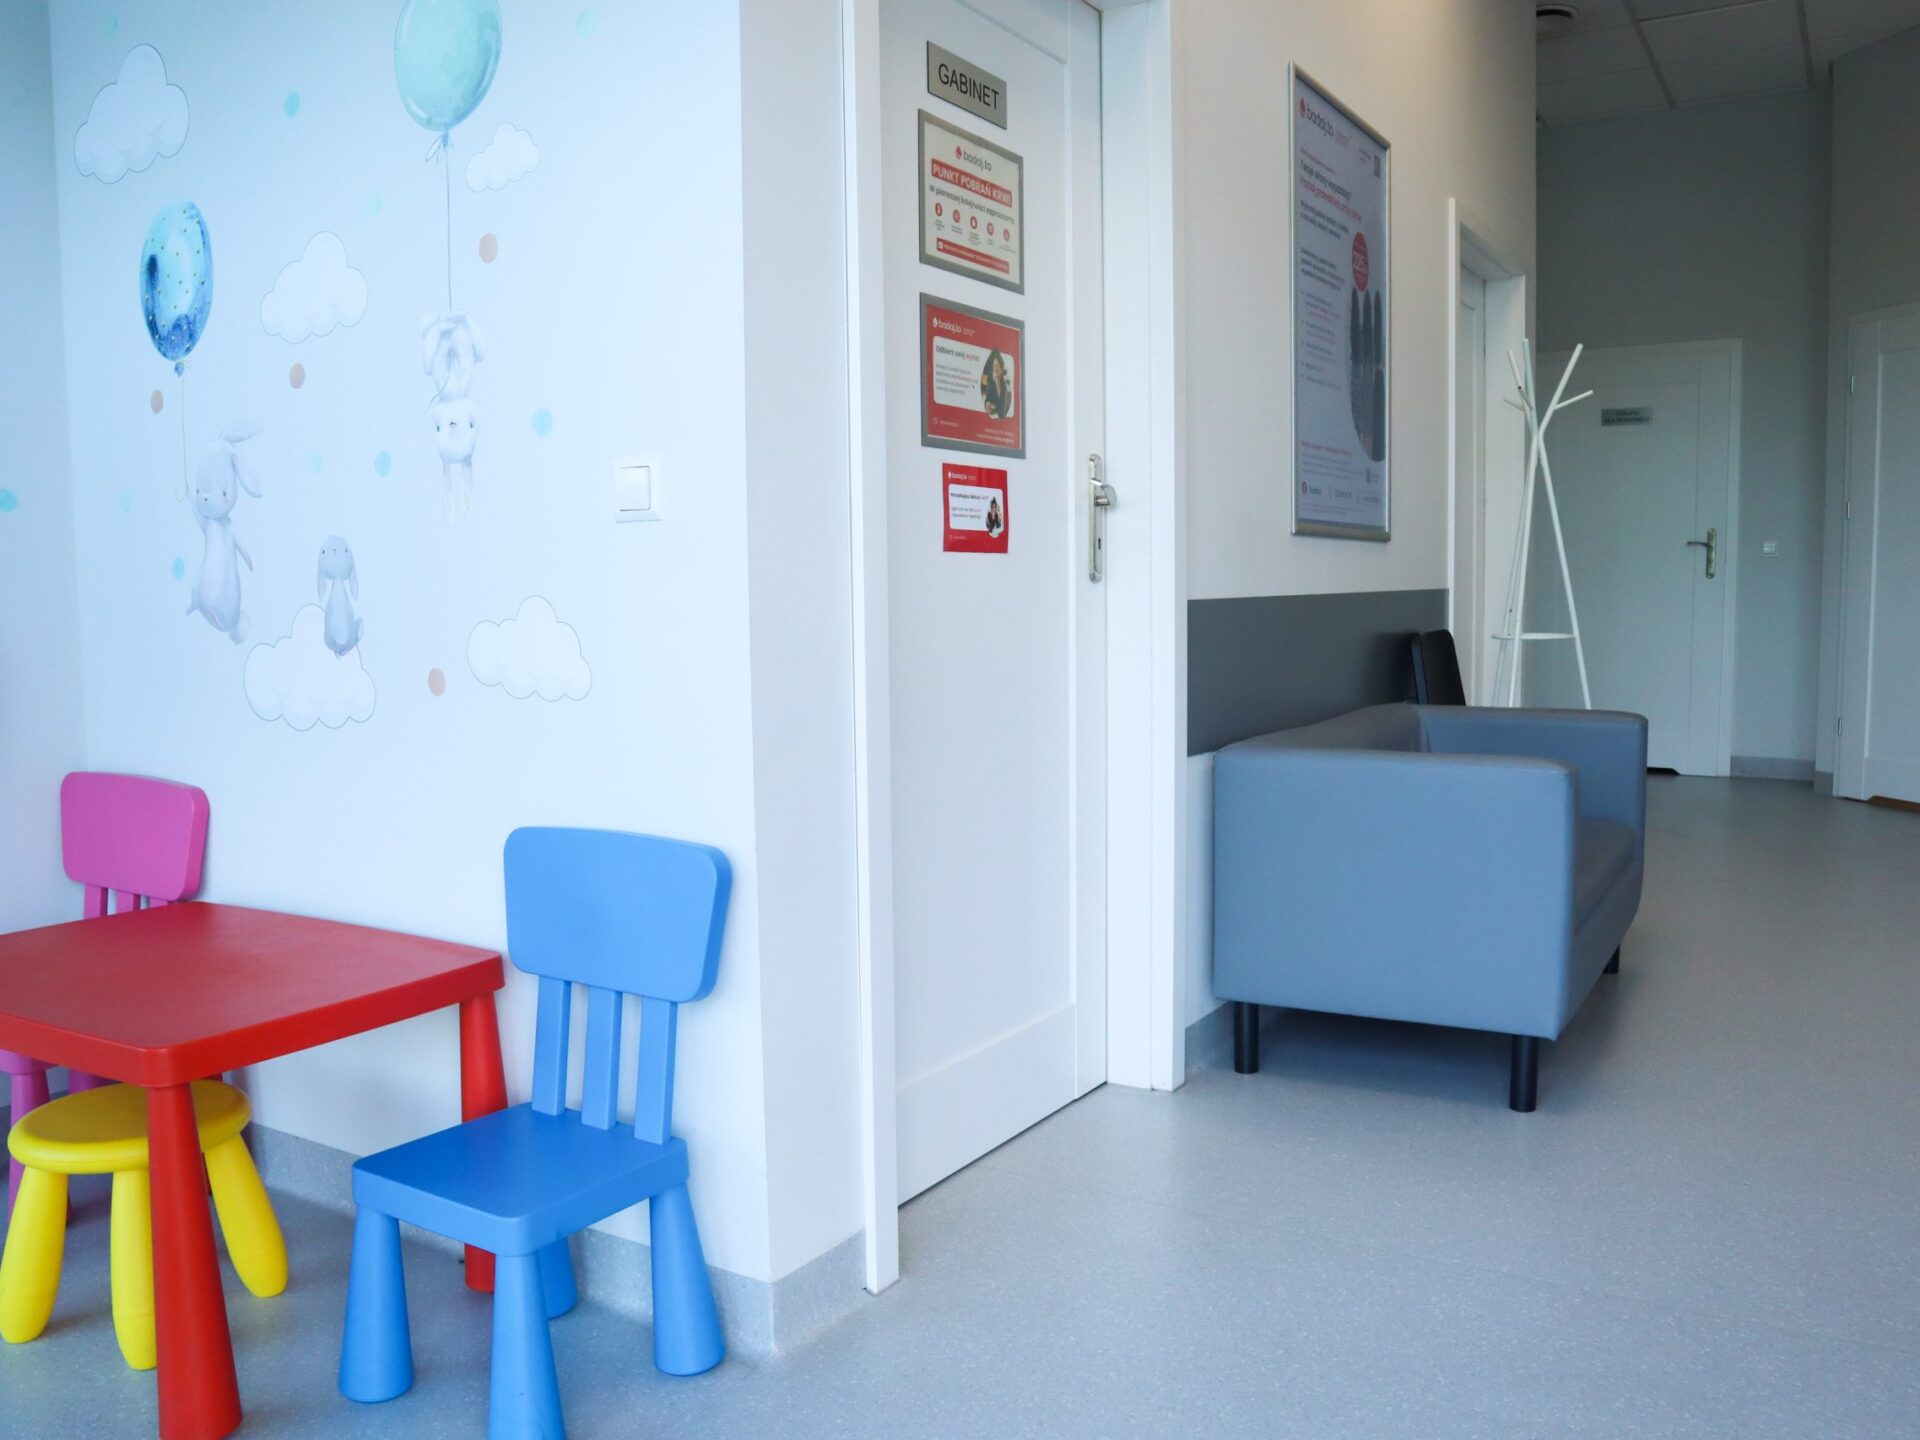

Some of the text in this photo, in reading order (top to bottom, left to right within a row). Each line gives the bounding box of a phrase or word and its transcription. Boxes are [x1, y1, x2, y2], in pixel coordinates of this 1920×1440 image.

[938, 63, 999, 109] GABINET
[932, 163, 1011, 206] PUNKT POBRAŃ KRWI
